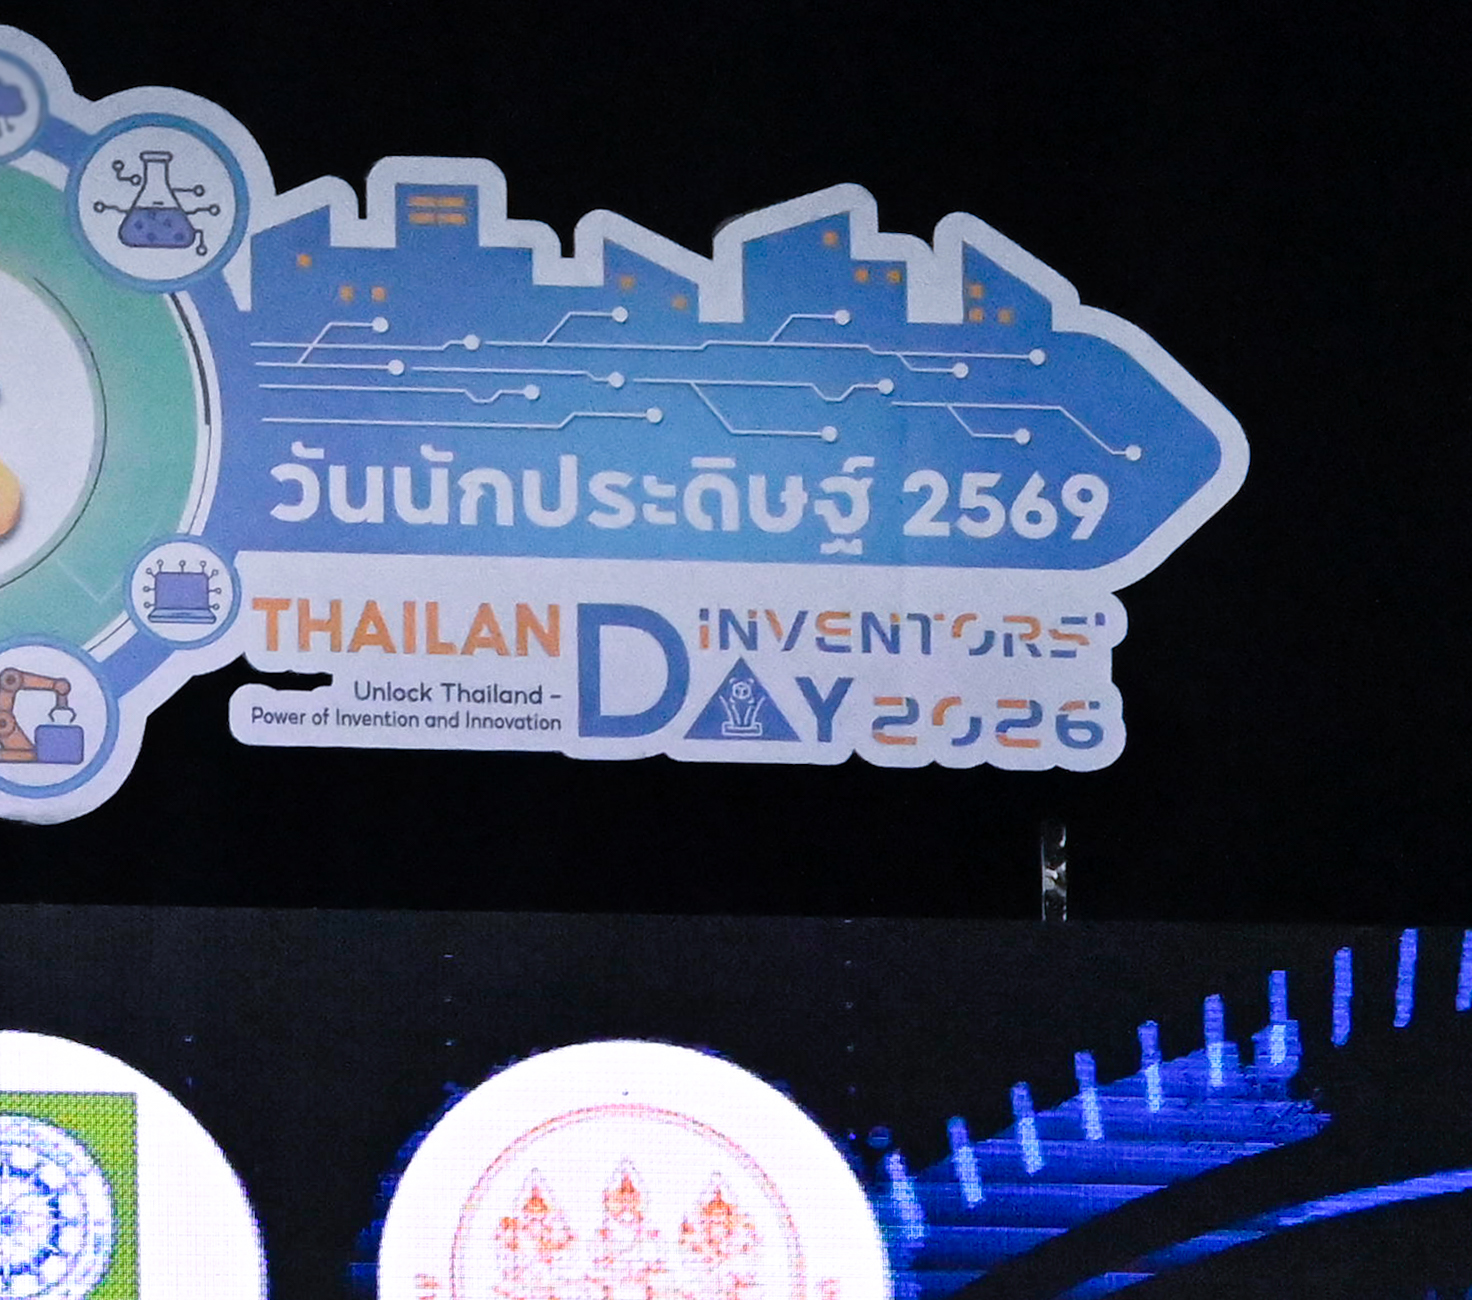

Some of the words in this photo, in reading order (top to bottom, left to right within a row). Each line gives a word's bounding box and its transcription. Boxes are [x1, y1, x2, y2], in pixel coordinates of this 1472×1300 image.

[270, 441, 874, 556] วันนักประดิษฐ์
[902, 470, 1108, 540] 2569
[354, 680, 432, 703] Unlock
[440, 682, 543, 705] Thailand
[251, 706, 306, 725] Power
[312, 707, 330, 726] of
[336, 708, 420, 729] Invention
[424, 710, 460, 729] and
[465, 710, 562, 732] Innovation
[871, 696, 1104, 750] 2026
